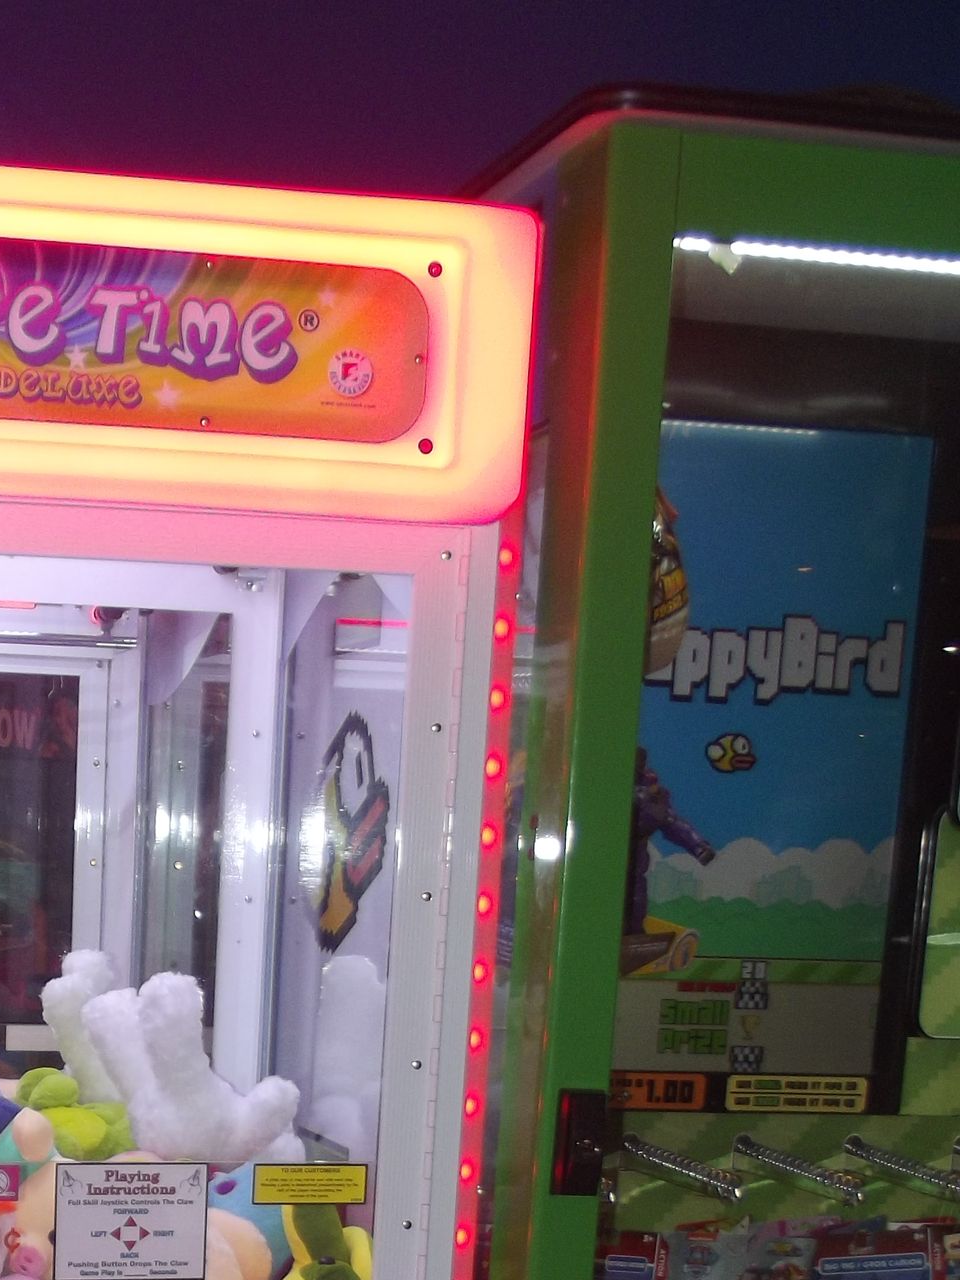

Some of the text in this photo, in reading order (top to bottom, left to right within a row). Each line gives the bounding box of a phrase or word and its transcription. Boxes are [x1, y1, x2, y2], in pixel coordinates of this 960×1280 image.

[104, 1170, 161, 1184] Playing
[86, 1183, 176, 1196] Instructions
[100, 1199, 129, 1207] Joystick
